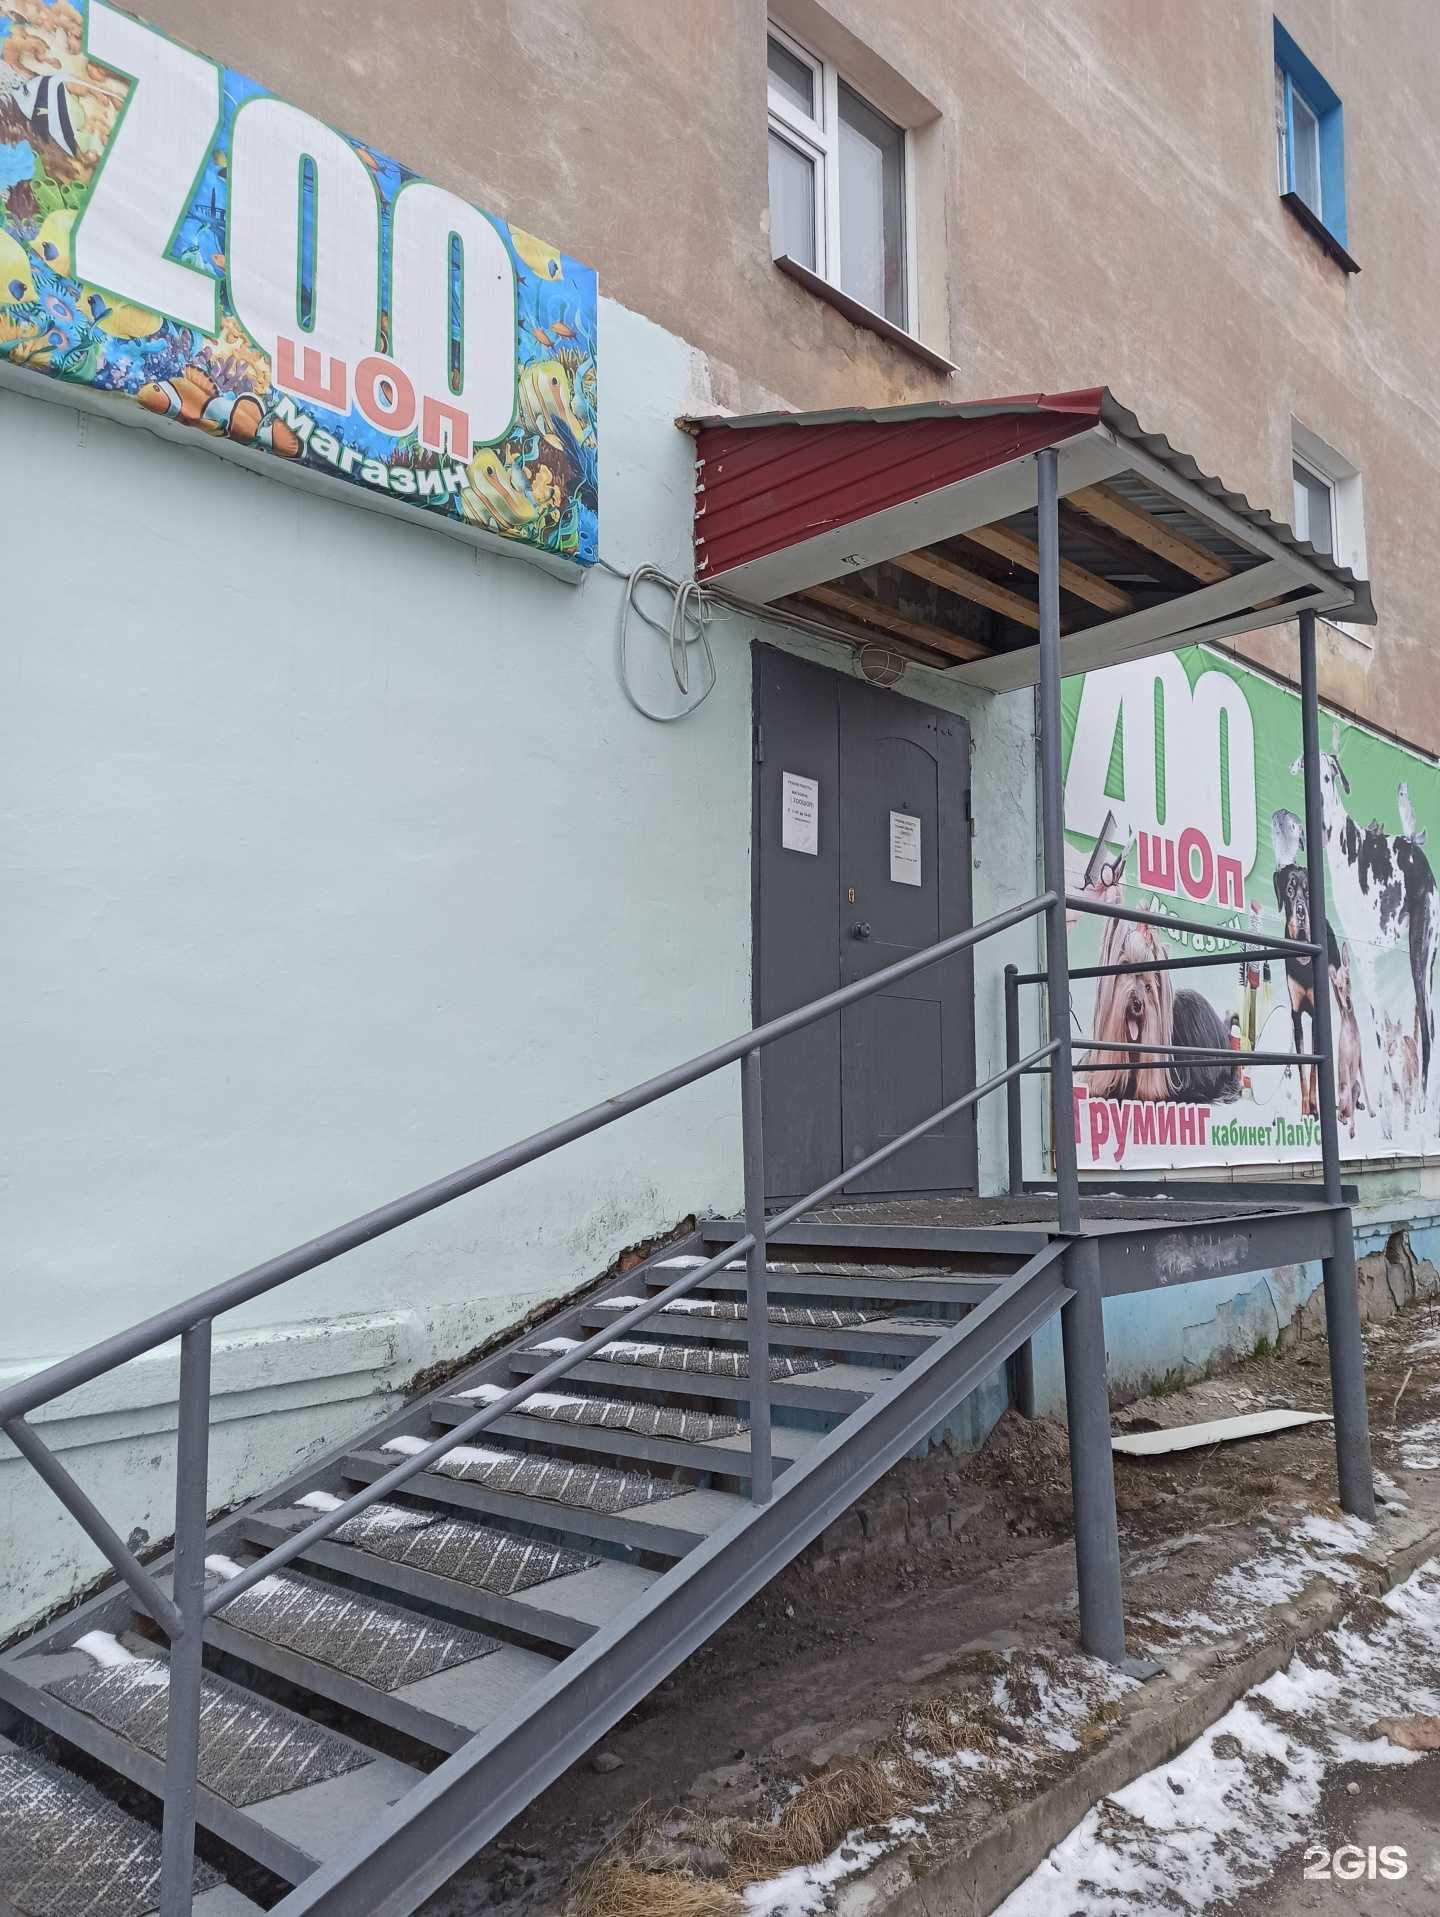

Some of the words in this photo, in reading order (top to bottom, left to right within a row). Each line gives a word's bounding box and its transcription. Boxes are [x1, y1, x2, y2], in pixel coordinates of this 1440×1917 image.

[275, 397, 470, 496] Магазин
[1072, 1086, 1211, 1162] Груминг
[1211, 1122, 1272, 1147] кабинет
